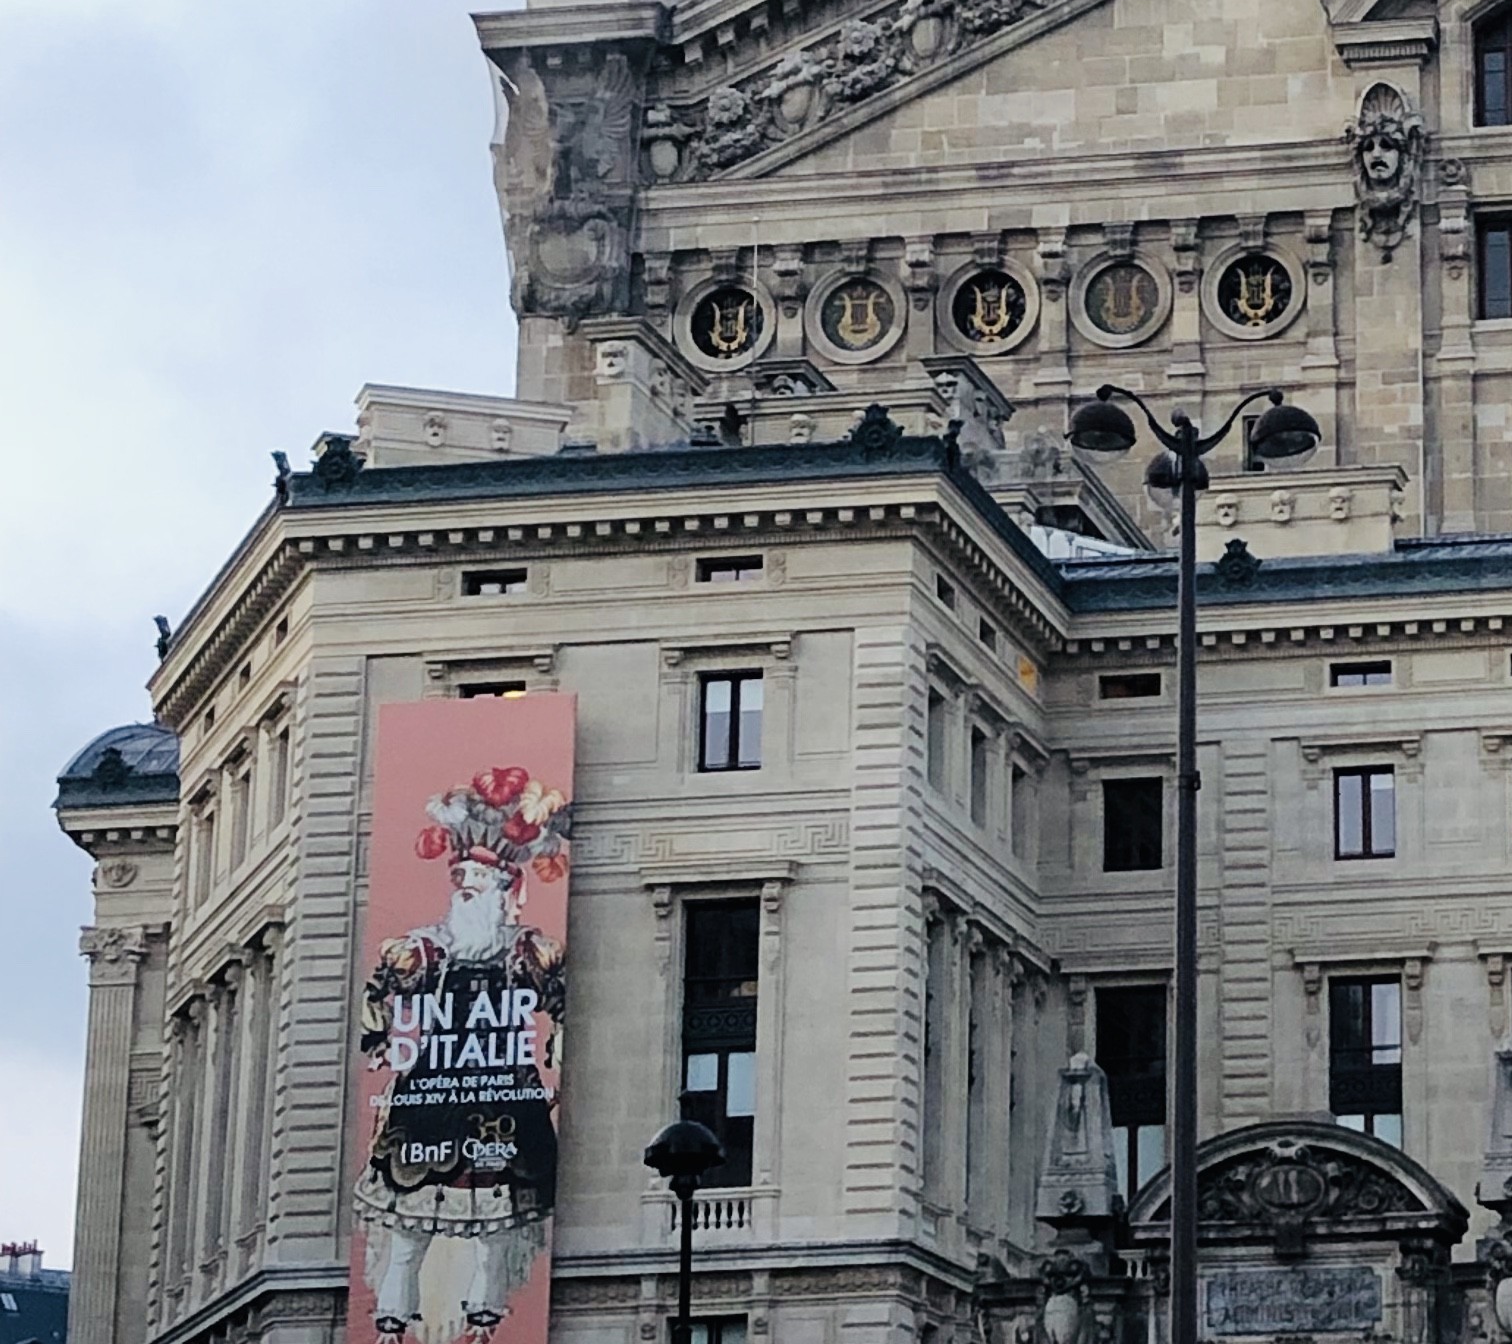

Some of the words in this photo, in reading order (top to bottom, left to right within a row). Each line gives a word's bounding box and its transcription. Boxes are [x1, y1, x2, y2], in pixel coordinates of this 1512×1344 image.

[391, 992, 454, 1033] UN
[464, 988, 539, 1029] AIR
[391, 1030, 538, 1072] D'ITALIE
[410, 1074, 459, 1090] L'OPÉRA
[462, 1076, 479, 1087] DE
[480, 1073, 515, 1087] PARIS
[460, 1090, 477, 1103] LA
[479, 1087, 555, 1102] RÉVOLUTION
